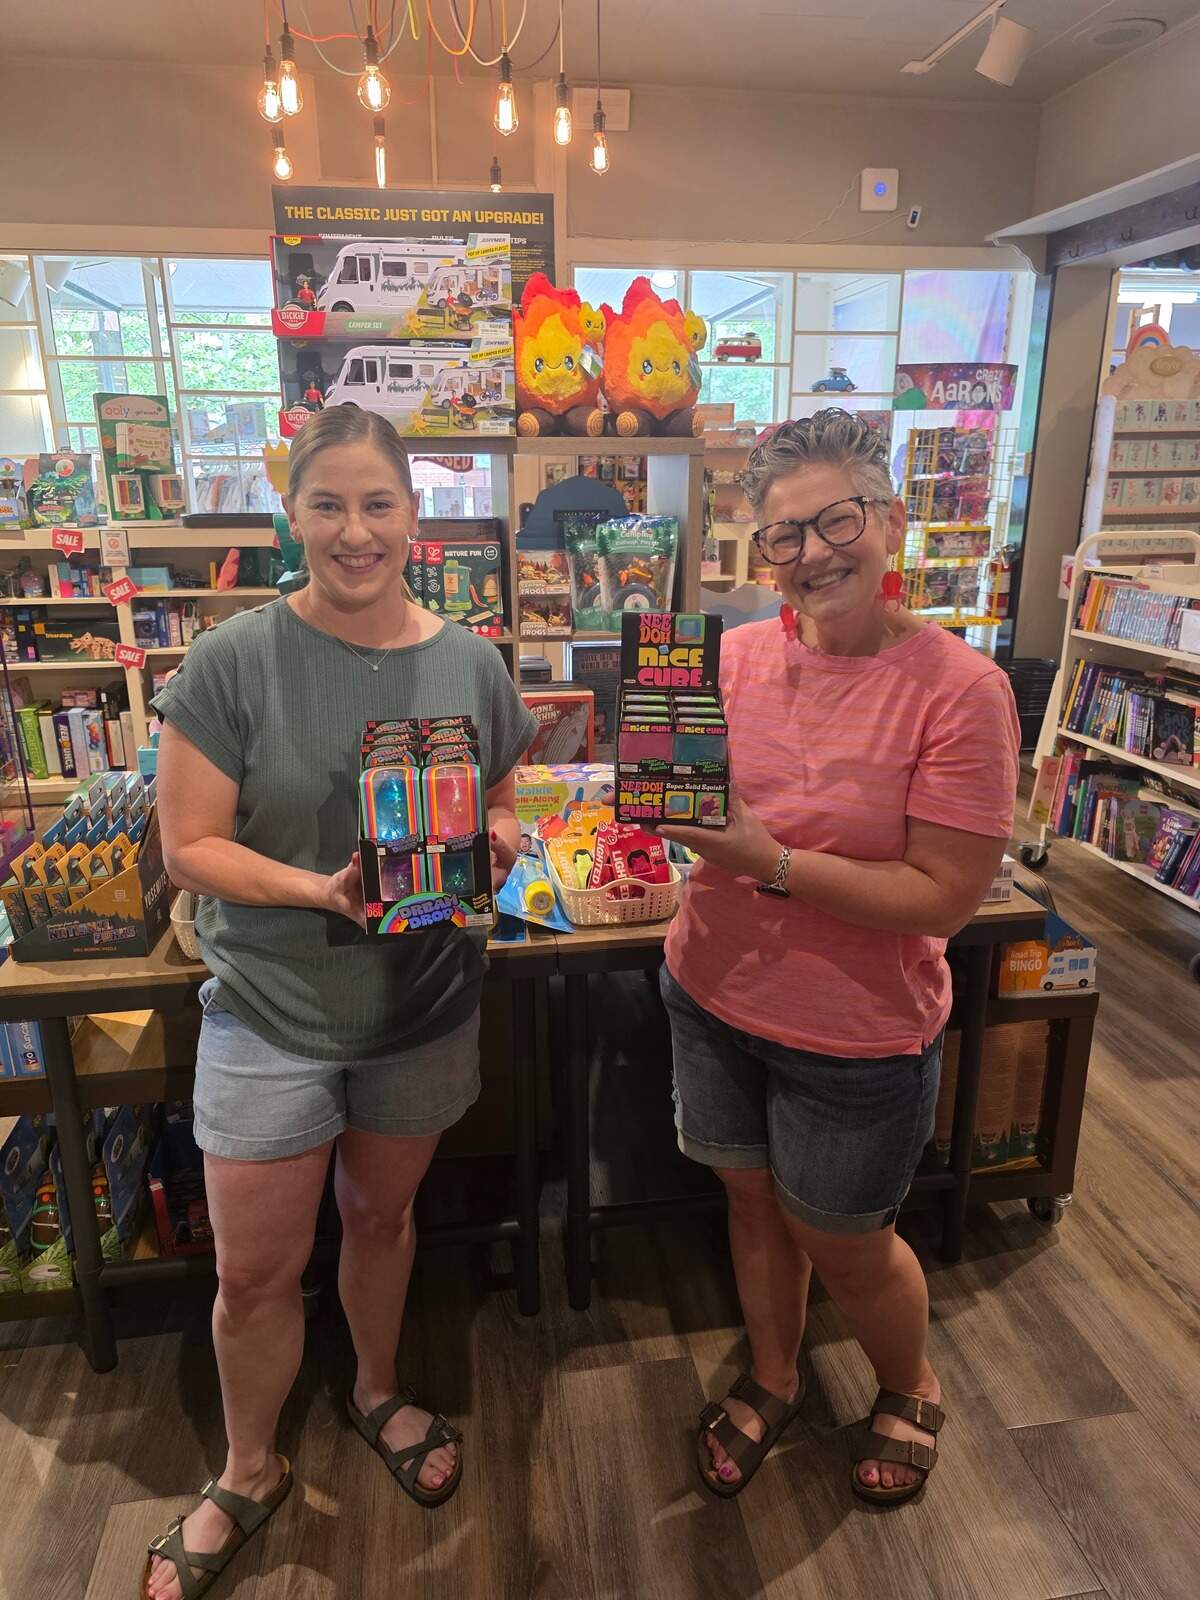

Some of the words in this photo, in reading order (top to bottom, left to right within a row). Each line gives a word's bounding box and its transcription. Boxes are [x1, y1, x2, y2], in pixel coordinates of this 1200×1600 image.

[284, 206, 314, 219] THE
[316, 207, 381, 220] CLASSIC
[383, 208, 418, 221] JUST
[421, 209, 449, 222] GOT
[452, 210, 472, 223] AN
[475, 211, 544, 224] UPGRADE!
[348, 321, 371, 329] CAMPER
[105, 405, 130, 418] ooly
[56, 534, 80, 546] SALE
[110, 582, 131, 600] SALE
[639, 613, 672, 629] NEE
[639, 626, 671, 644] DOH
[118, 649, 142, 663] SALE
[638, 667, 703, 687] CUBE
[530, 703, 555, 715] GONE
[371, 744, 408, 758] DREAM
[376, 752, 404, 762] DROP
[431, 743, 468, 757] DREAM
[438, 750, 465, 762] DROP
[619, 805, 662, 818] CUBE
[649, 844, 661, 852] TRY
[592, 836, 606, 884] LIGHTED
[612, 850, 630, 900] LIGHED
[366, 902, 384, 910] NEE
[398, 894, 459, 920] DREAM
[366, 909, 384, 918] DOH
[408, 907, 454, 930] DROP
[1009, 959, 1043, 971] BINGO
